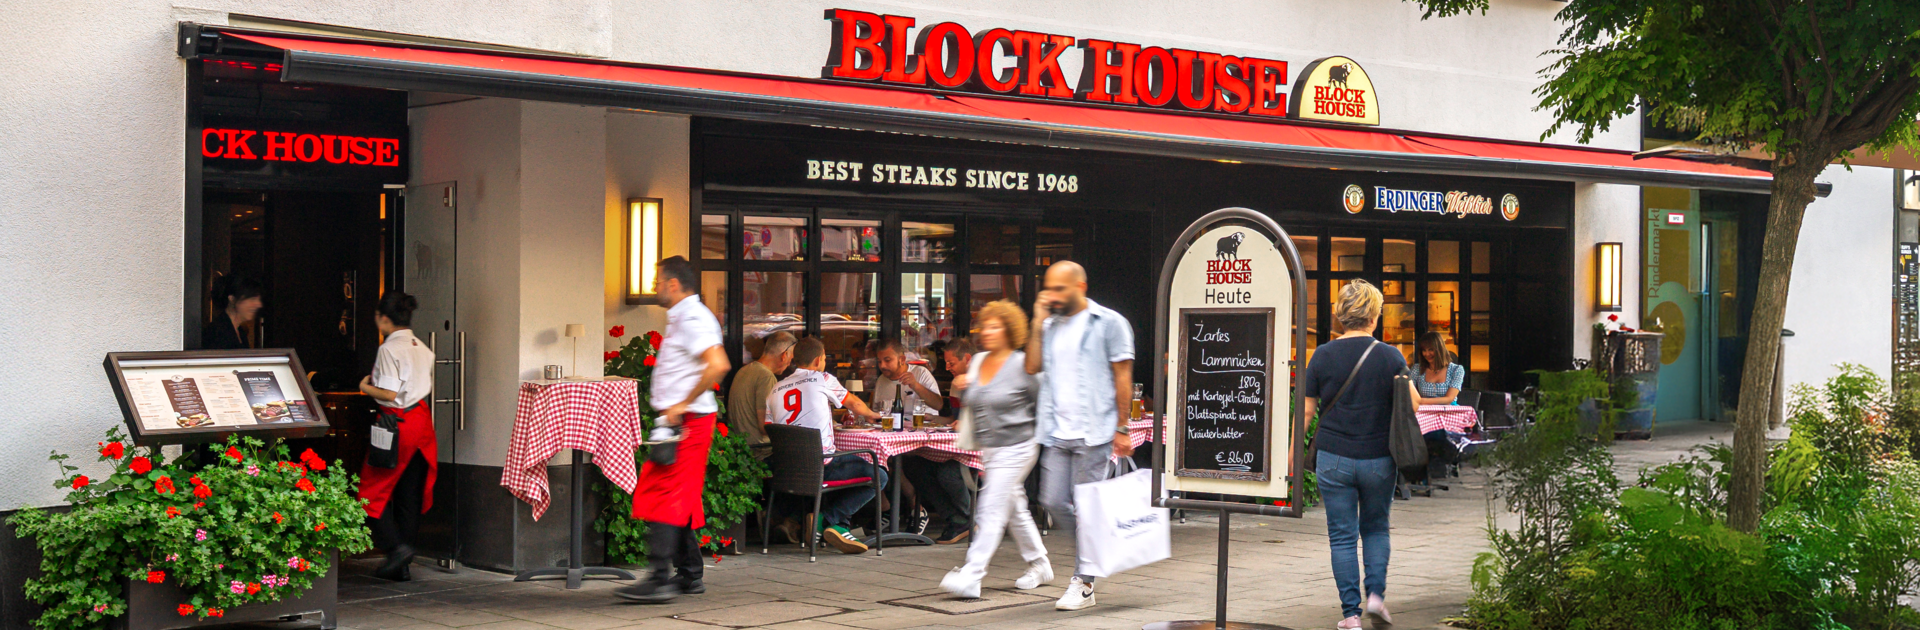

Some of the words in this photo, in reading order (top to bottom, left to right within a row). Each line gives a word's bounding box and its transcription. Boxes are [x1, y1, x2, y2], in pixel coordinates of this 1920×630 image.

[824, 8, 1075, 98] BLOCK
[1077, 39, 1288, 118] HOUSE
[1314, 85, 1366, 104] BLOCK
[1314, 100, 1366, 119] HOUSE
[263, 131, 399, 167] HOUSE
[806, 159, 863, 181] BEST
[872, 163, 958, 187] STEAKS
[965, 169, 1030, 191] SINCE
[1037, 173, 1079, 193] 1968
[1374, 186, 1446, 215] ERDINGER
[1446, 190, 1494, 219] Weißbier
[1647, 208, 1660, 298] Rindermarkt
[1206, 259, 1252, 272] BLOCK
[1206, 272, 1252, 285] HOUSE
[1205, 288, 1252, 304] Heute
[1192, 322, 1230, 342] Zartes
[1201, 349, 1265, 368] Lammrücken
[1238, 375, 1261, 395] 180g
[1187, 389, 1200, 402] mit
[784, 388, 802, 425] 9
[1187, 405, 1237, 425] Blattspinat
[1238, 410, 1257, 423] und
[1187, 425, 1245, 439] Kräuterbutter
[1215, 451, 1226, 463] €
[1227, 450, 1254, 465] 26,00
